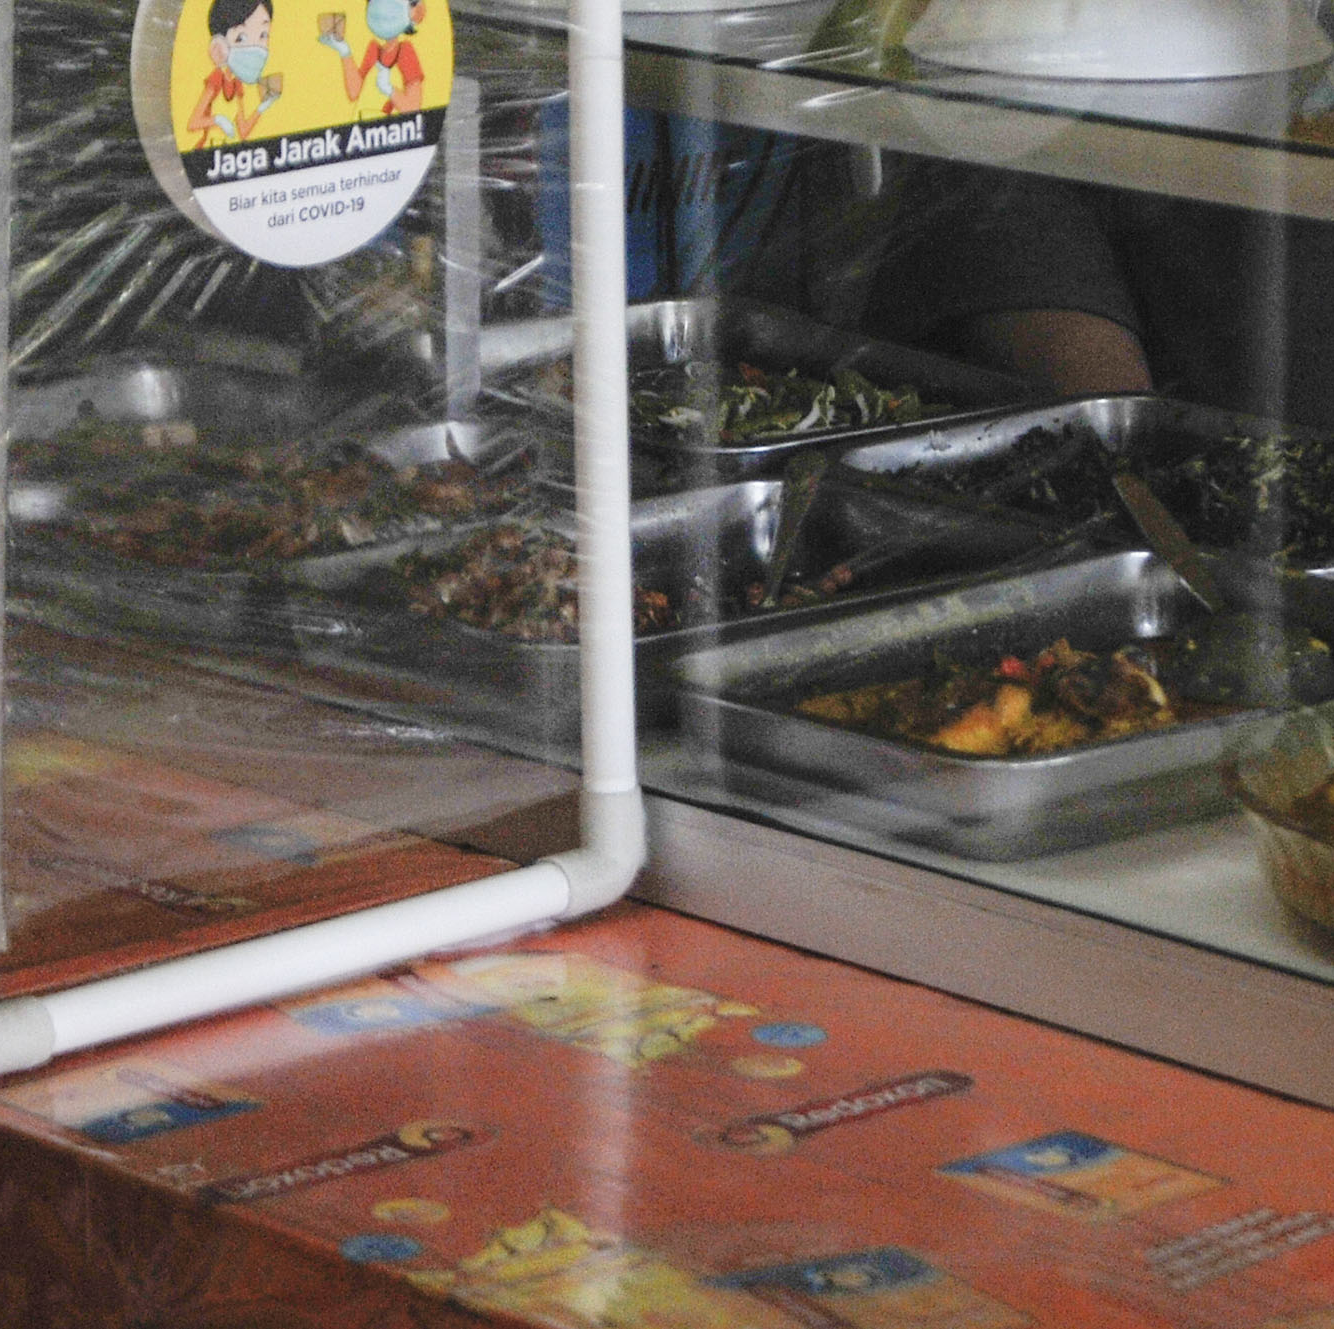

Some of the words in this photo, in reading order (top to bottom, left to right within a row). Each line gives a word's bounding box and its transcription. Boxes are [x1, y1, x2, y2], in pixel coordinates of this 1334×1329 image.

[206, 148, 268, 179] Jaga
[273, 133, 342, 169] Jarak
[344, 115, 426, 156] Aman!
[228, 194, 258, 213] Biar
[261, 186, 288, 207] kita
[291, 181, 337, 200] semua
[339, 167, 403, 193] terhindar
[267, 207, 296, 229] dari
[298, 197, 366, 224] COVID-19
